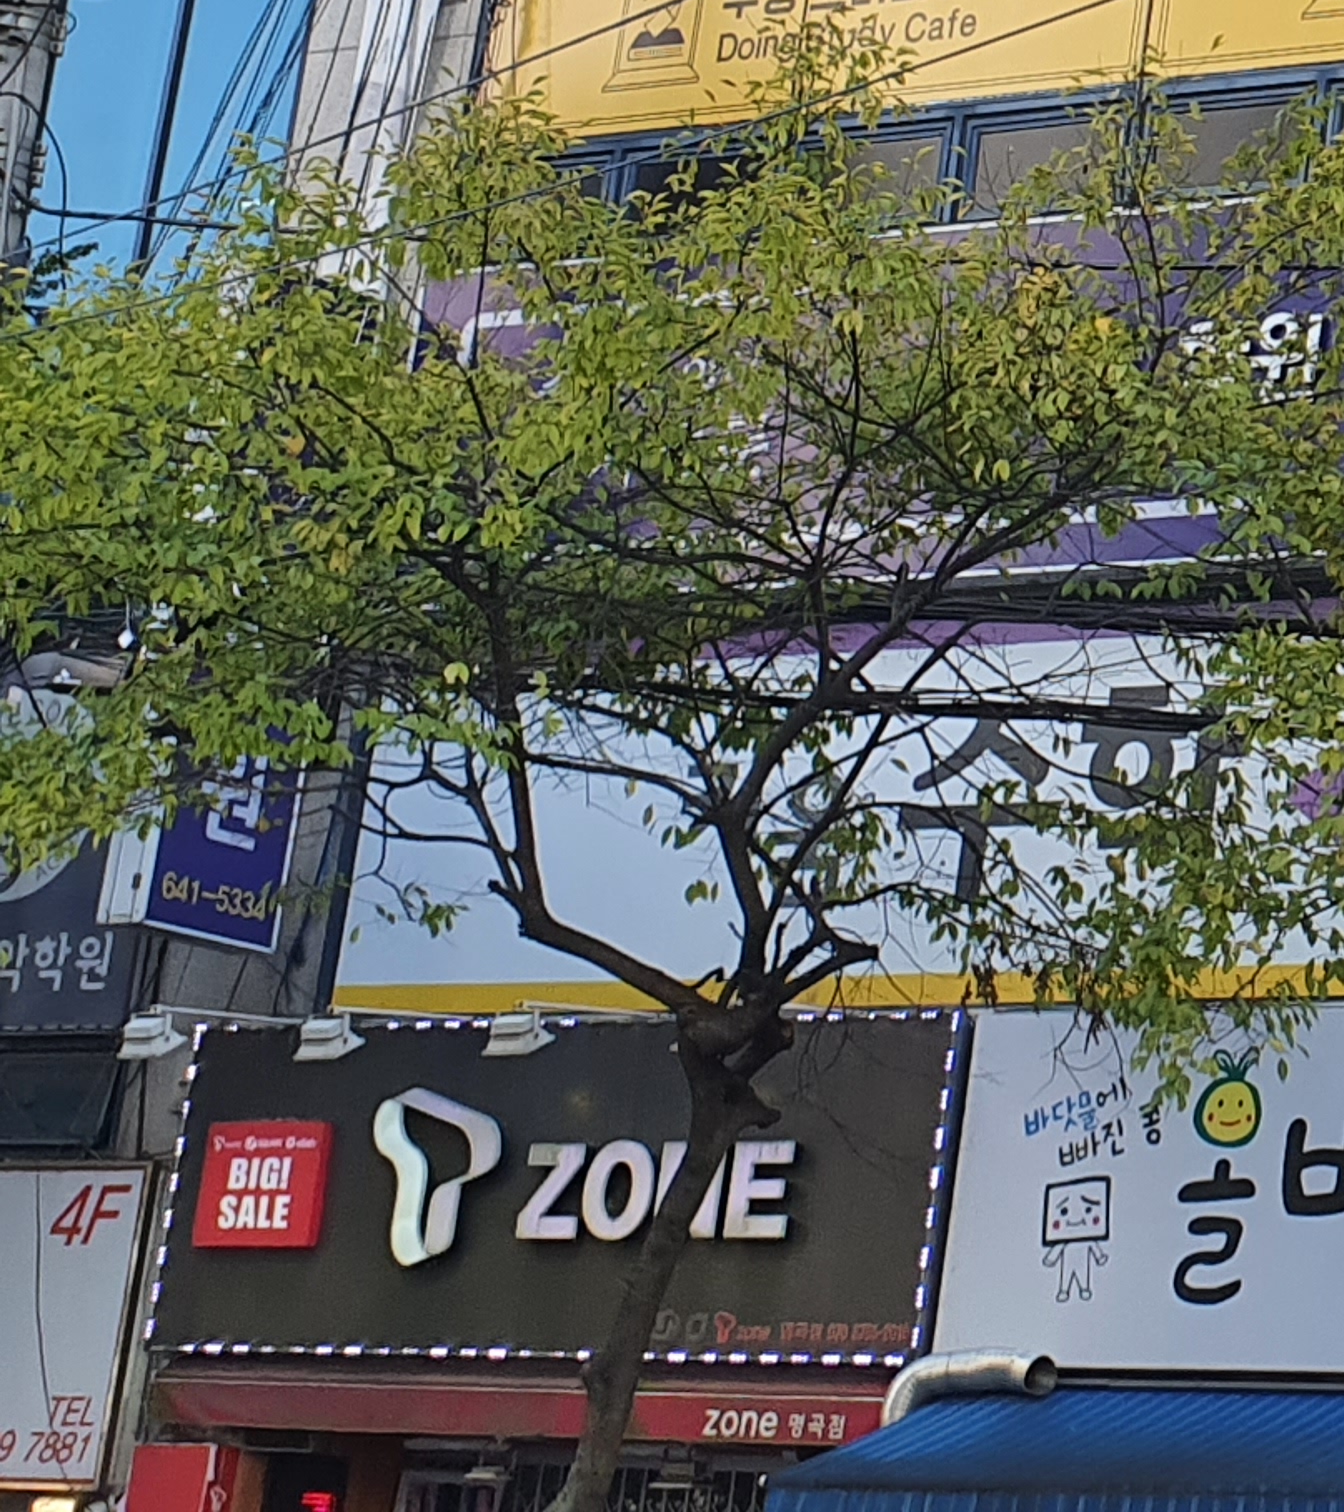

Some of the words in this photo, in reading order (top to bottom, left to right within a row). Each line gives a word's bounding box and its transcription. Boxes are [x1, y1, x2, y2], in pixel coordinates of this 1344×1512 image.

[904, 7, 977, 44] Cafe
[161, 871, 268, 923] 641-5334
[1058, 1117, 1125, 1167] 빠진
[227, 1156, 293, 1191] BIG!
[49, 1183, 133, 1247] 4F
[217, 1194, 292, 1230] SALE
[51, 1395, 95, 1427] TEL
[702, 1407, 780, 1439] zone
[23, 1431, 93, 1465] 7881
